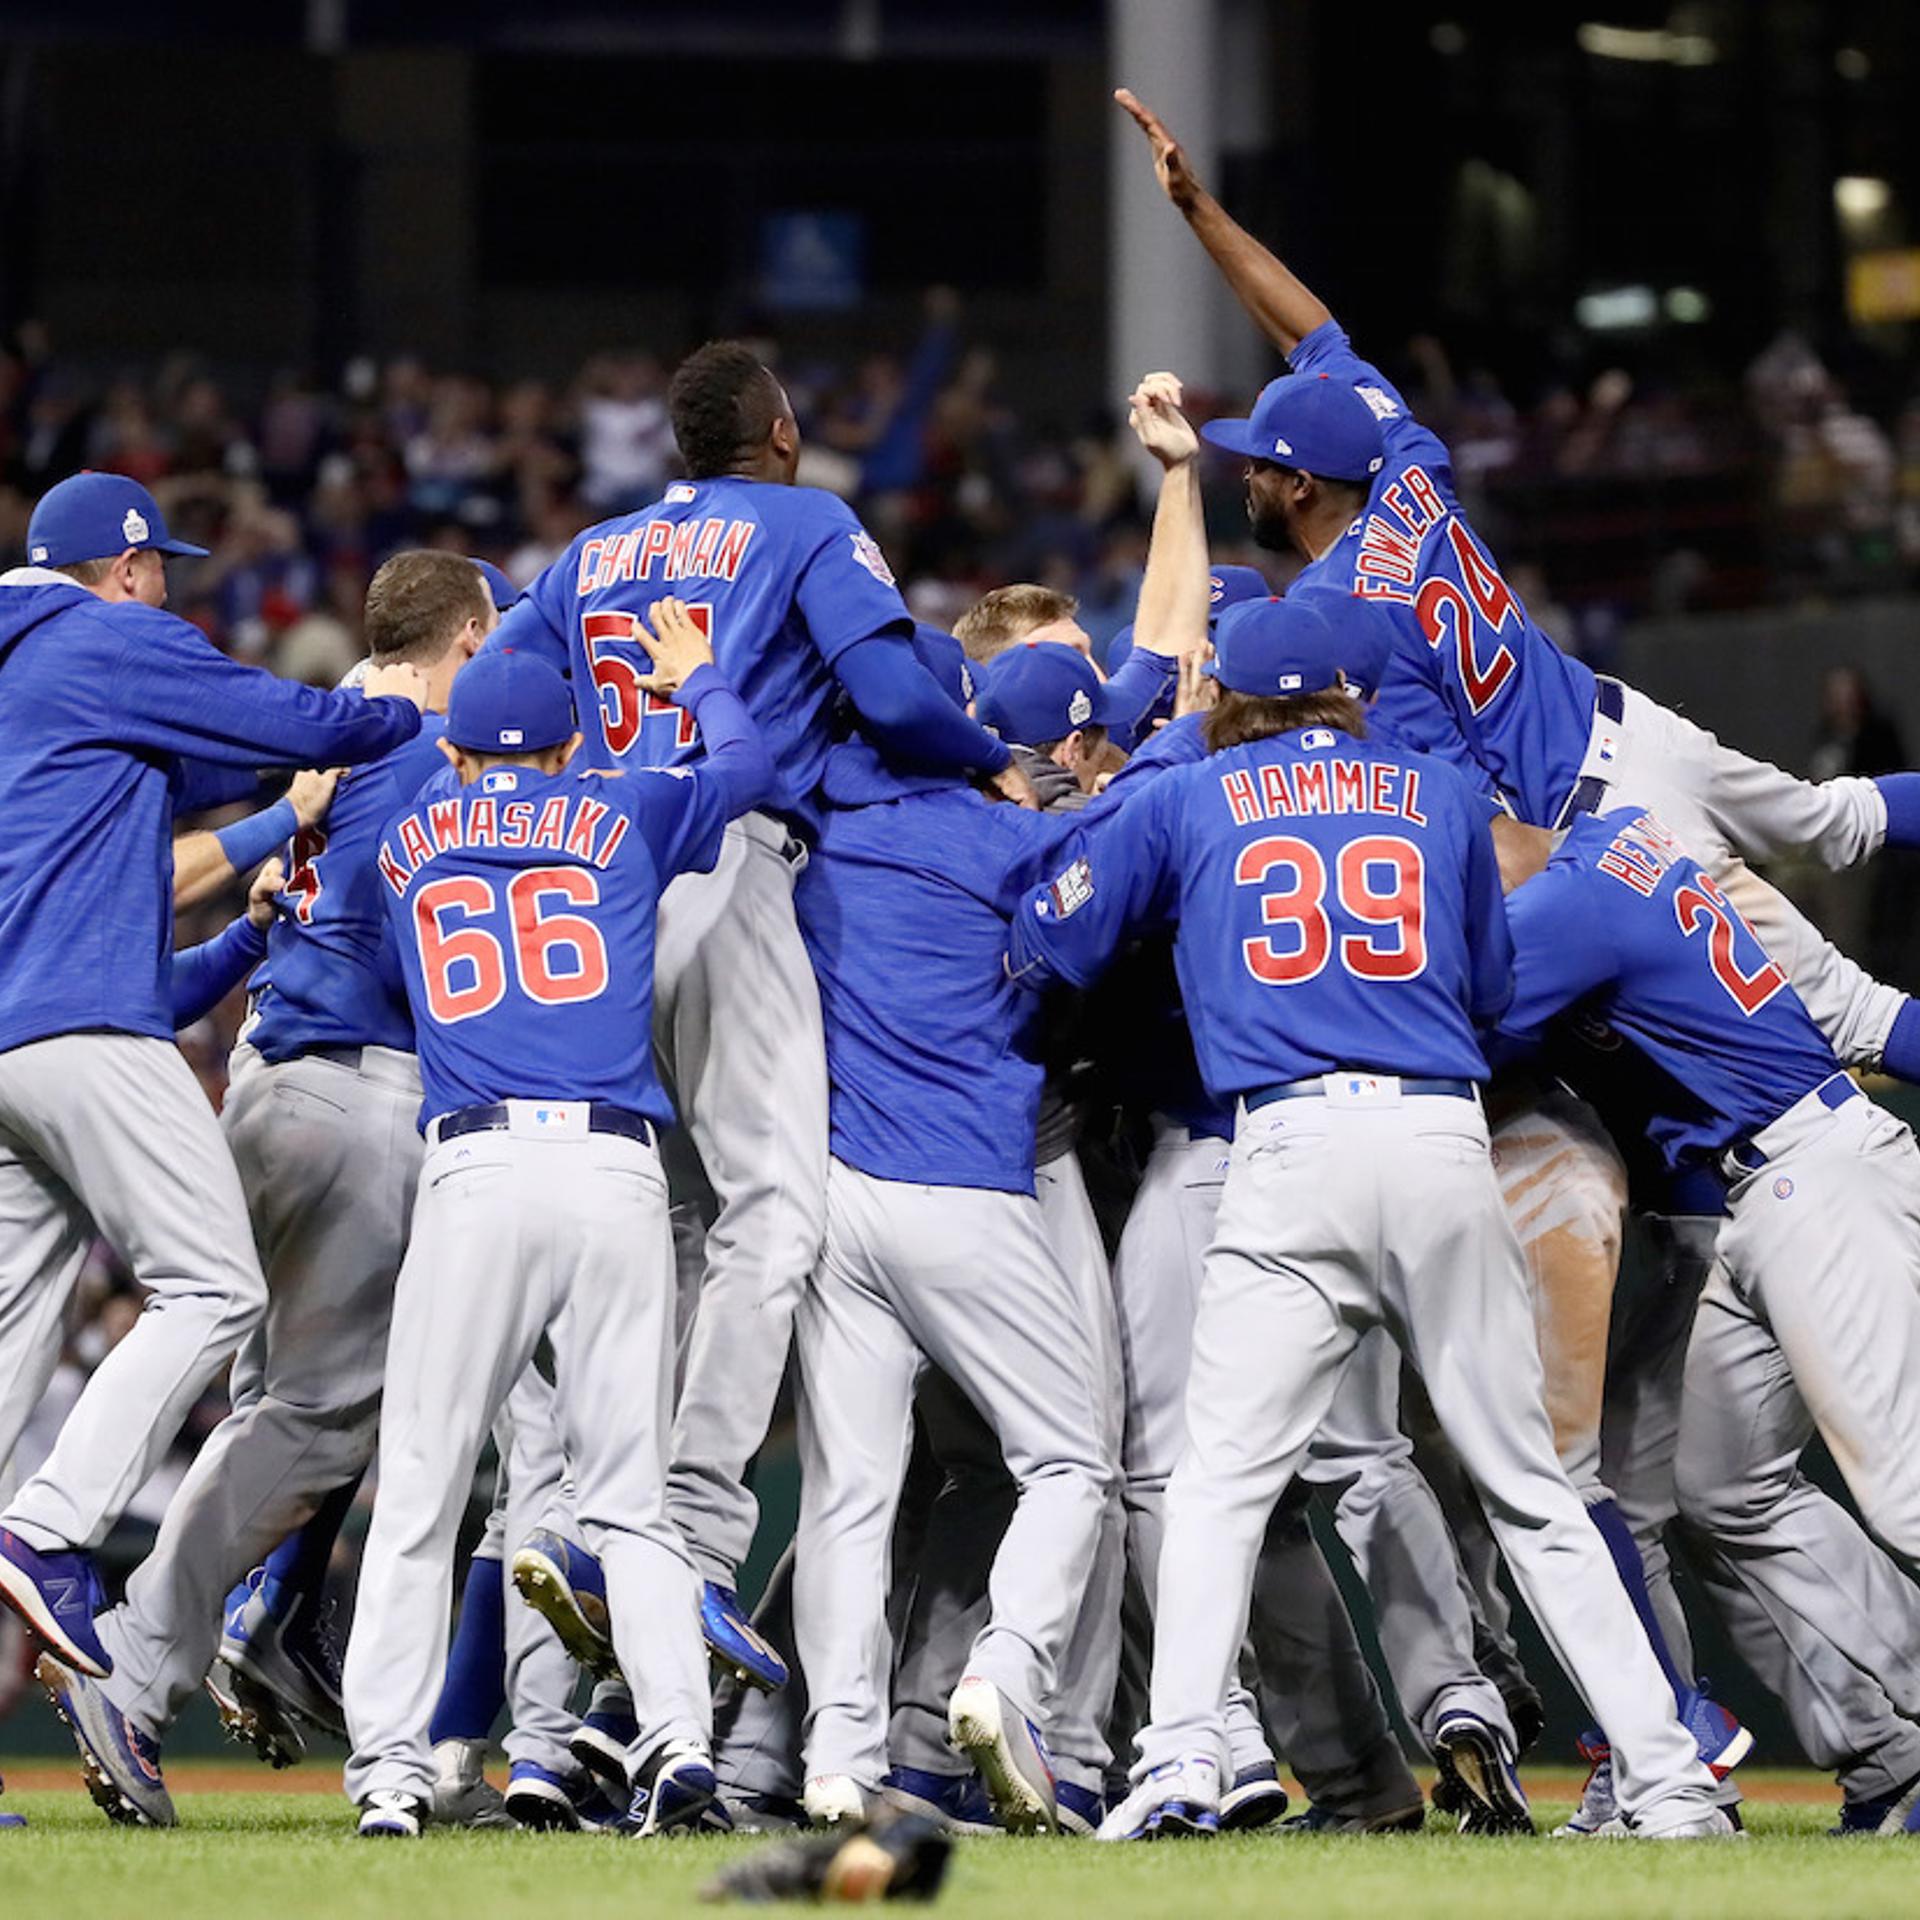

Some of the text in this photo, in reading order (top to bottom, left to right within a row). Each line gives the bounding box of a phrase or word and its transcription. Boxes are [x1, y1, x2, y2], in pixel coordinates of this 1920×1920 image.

[576, 520, 755, 596] CHAPMAN
[1353, 464, 1448, 605] FOWLER
[1414, 516, 1525, 717] 24
[378, 796, 630, 897] KAWASAKI
[1221, 758, 1427, 827] HAMMEL
[412, 866, 609, 1025] 66
[1235, 835, 1427, 985] 39
